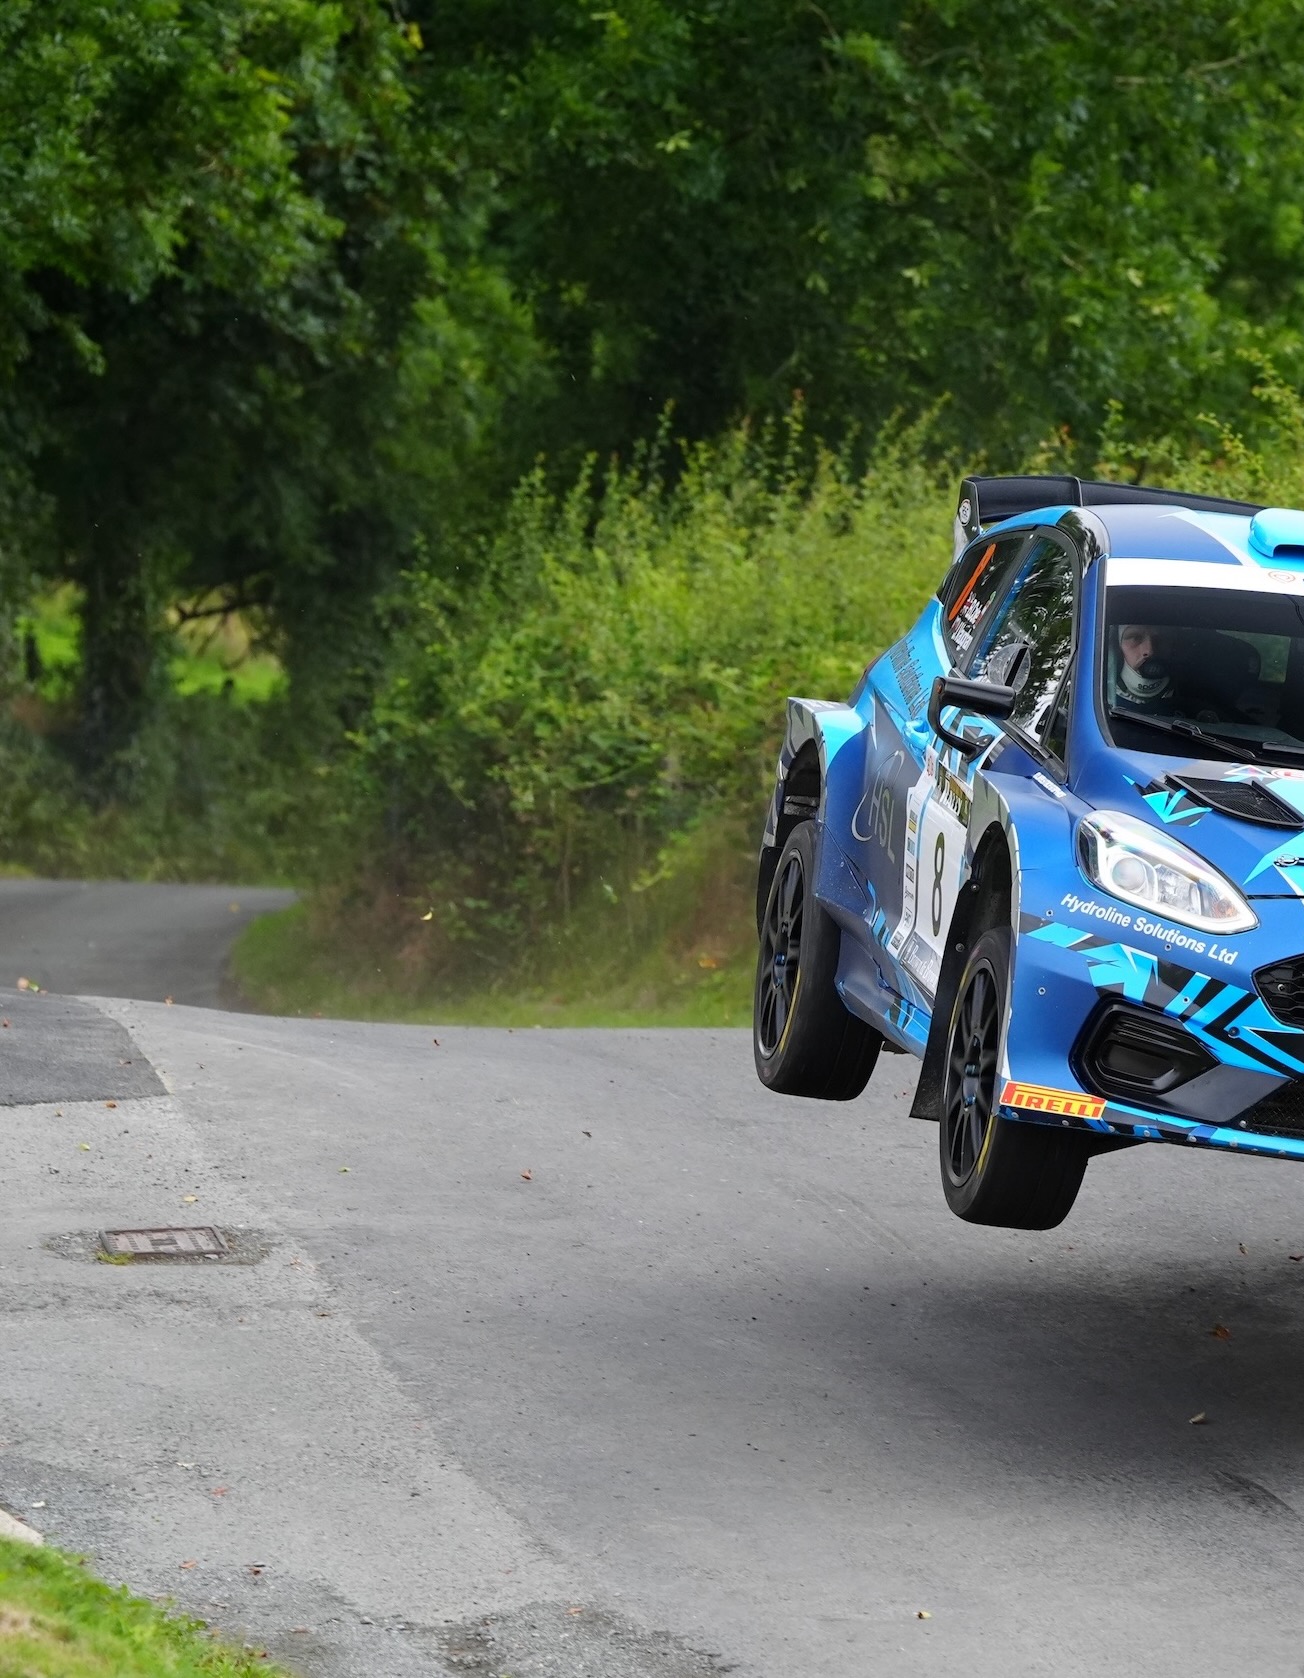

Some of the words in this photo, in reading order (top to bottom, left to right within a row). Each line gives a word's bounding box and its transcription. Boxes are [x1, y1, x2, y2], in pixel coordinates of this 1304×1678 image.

[931, 831, 945, 937] 8
[1060, 893, 1132, 929] Hydroline
[1132, 916, 1207, 954] Solutions
[1208, 940, 1239, 967] Ltd
[1002, 1083, 1105, 1119] PIRELLI
